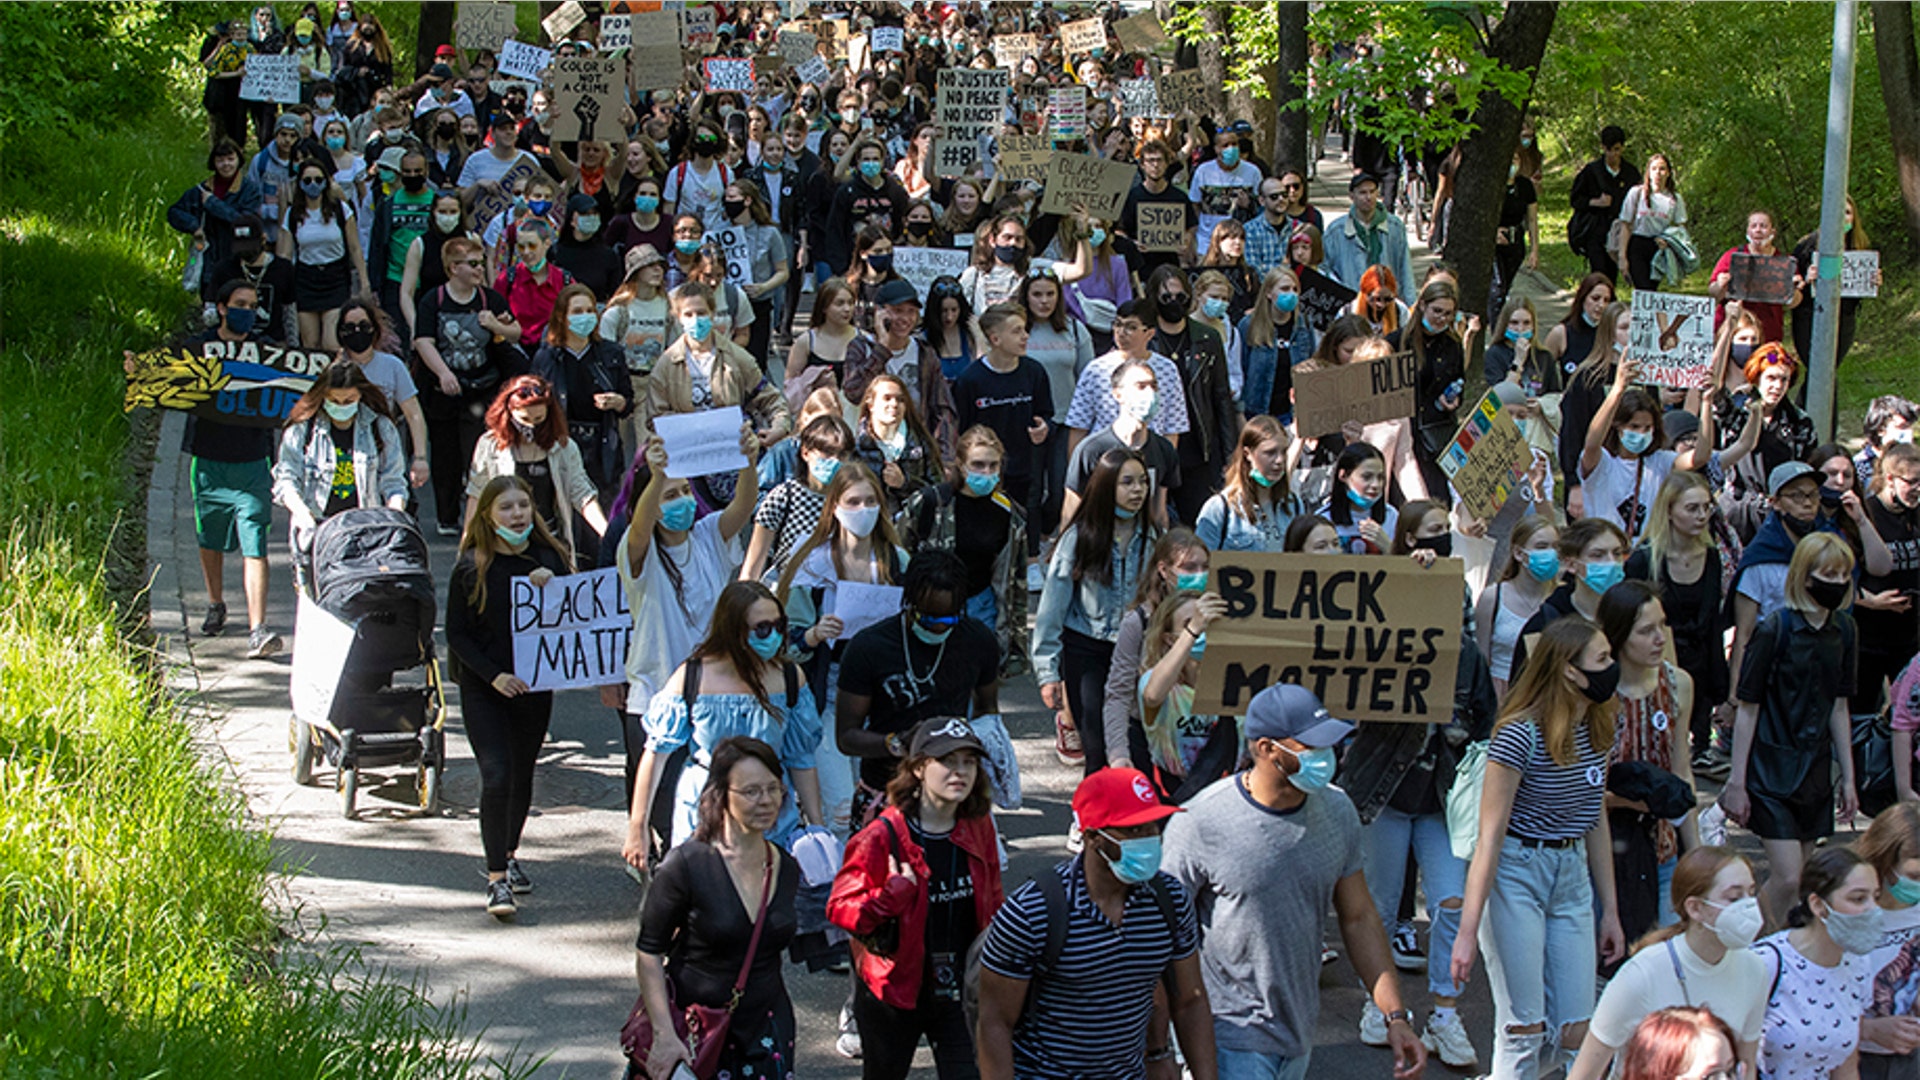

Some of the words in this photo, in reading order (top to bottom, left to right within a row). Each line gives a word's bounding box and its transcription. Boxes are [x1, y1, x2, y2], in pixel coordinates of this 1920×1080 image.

[467, 6, 505, 21] WE
[560, 60, 599, 72] COLOR
[603, 60, 616, 74] IS
[708, 60, 751, 71] BLACK
[579, 73, 602, 82] NOT
[940, 72, 956, 87] NO
[958, 72, 1007, 88] JUSTICE
[562, 82, 571, 92] A
[573, 82, 609, 94] CRIME
[946, 90, 964, 105] NO
[966, 90, 1000, 105] PEACE
[943, 107, 960, 122] NO
[963, 107, 1002, 122] RACIST
[1058, 158, 1107, 176] BLACK
[1062, 176, 1100, 191] LIVES
[1142, 208, 1182, 225] STOP
[706, 230, 736, 246] NO
[1142, 230, 1182, 246] RACISM
[1694, 316, 1703, 338] I
[1371, 354, 1415, 396] POLICE
[1217, 567, 1387, 621] BLACK
[514, 576, 607, 632] BLACK
[1314, 625, 1444, 665] LIVES
[1222, 663, 1432, 714] MATTER
